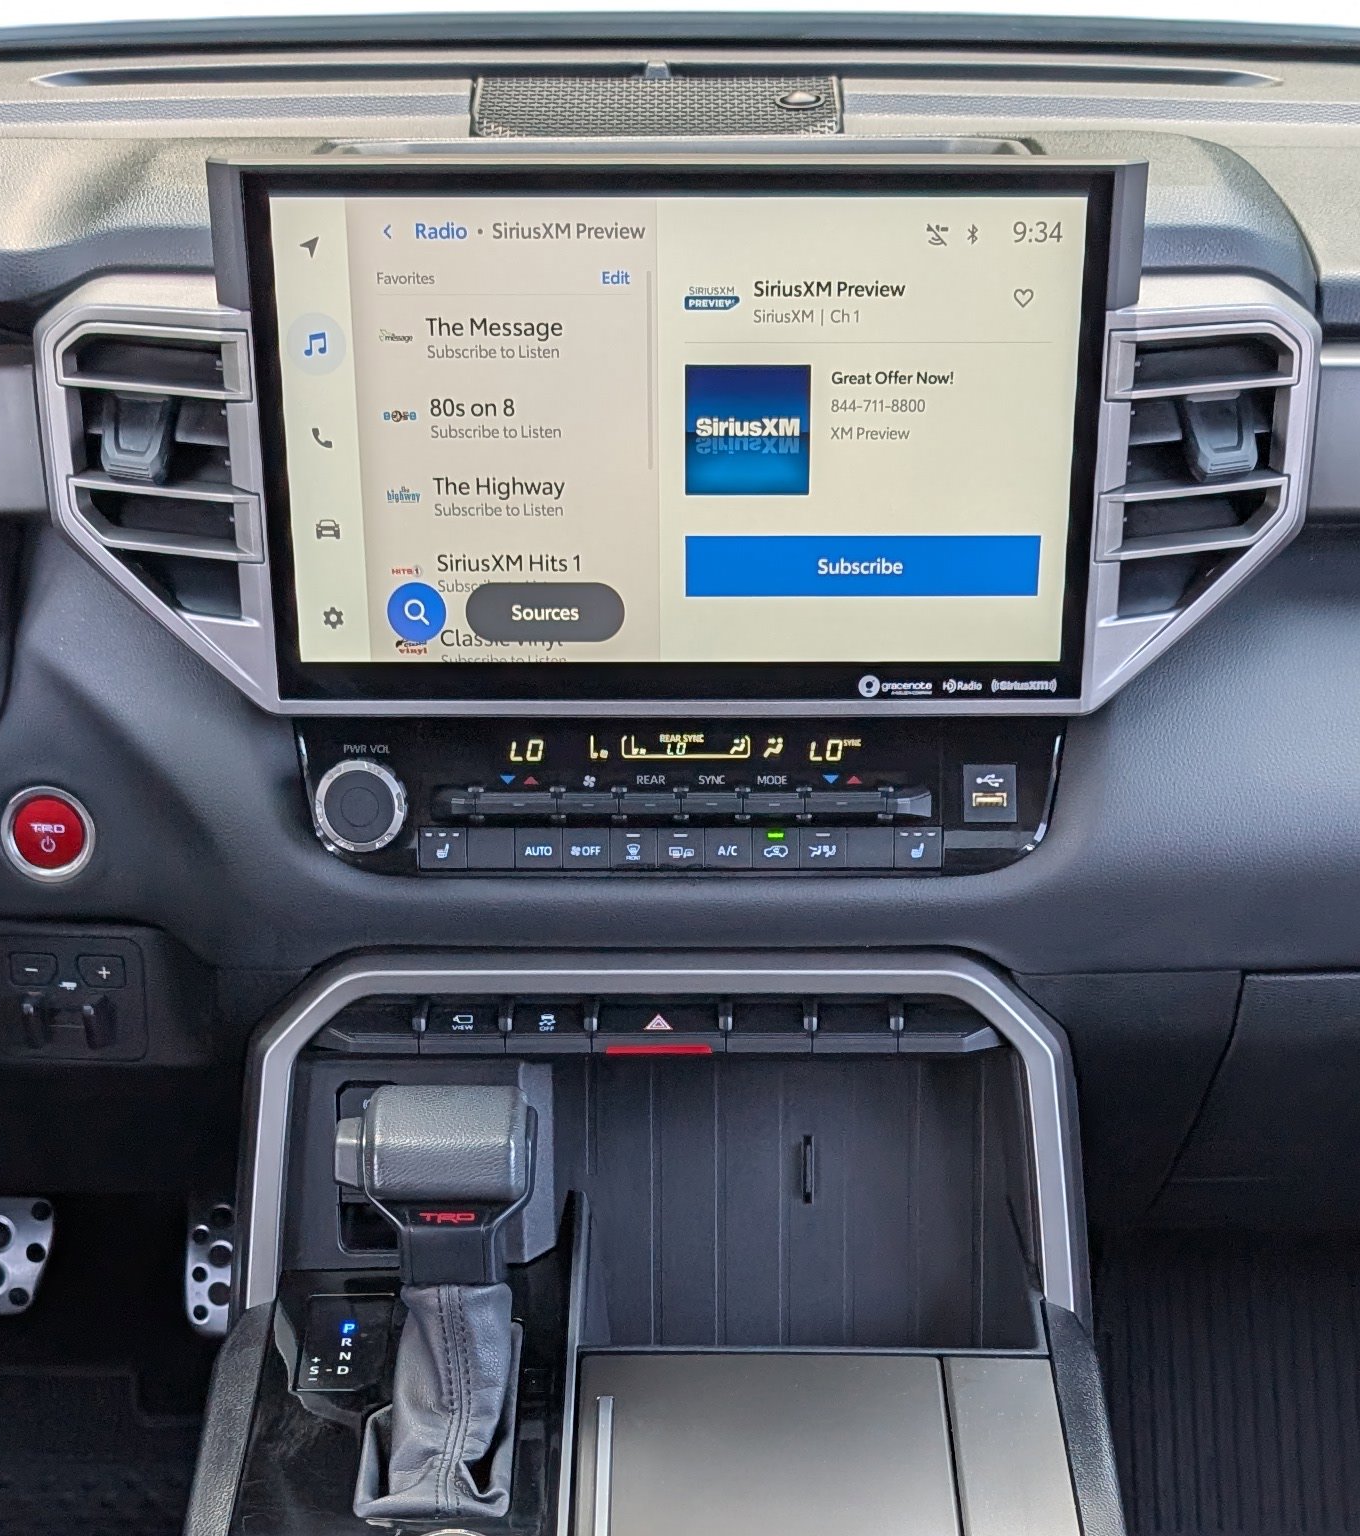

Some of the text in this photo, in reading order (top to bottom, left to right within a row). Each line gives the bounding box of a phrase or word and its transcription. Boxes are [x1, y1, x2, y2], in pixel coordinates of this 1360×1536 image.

[415, 222, 646, 240] Radio SiriusXM Preview
[1013, 222, 1062, 244] 9:34
[376, 272, 435, 285] Favorites
[602, 270, 631, 285] Edit
[754, 281, 905, 299] SiriusXM Preview
[753, 310, 814, 324] SiriusXM
[831, 310, 850, 324] Ch
[854, 310, 860, 324] 1
[426, 317, 564, 342] The Message
[427, 345, 560, 359] Subscribe to Listen
[831, 371, 954, 385] Great Offer Now!
[430, 399, 466, 417] 80s
[471, 403, 497, 417] on
[503, 399, 515, 417] 8
[830, 399, 926, 413] 844-711-8800
[430, 425, 562, 439] Subscribe to Listen
[695, 416, 801, 438] SiriusXM
[830, 427, 910, 442] XM Preview
[433, 477, 565, 501] The Highway
[434, 503, 564, 517] Subscribe to Listen
[437, 554, 581, 572] SiriusXM Hits 1
[817, 558, 904, 575] Subscribe
[511, 605, 580, 621] Sources
[881, 680, 933, 690] gracenote
[957, 681, 982, 690] Radio
[660, 734, 704, 743] REAR SYNC
[343, 744, 391, 753] PWR VOL
[636, 775, 666, 784] REAR
[698, 775, 726, 785] SYNC
[757, 775, 788, 784] MODE
[30, 823, 65, 834] TRD
[525, 846, 553, 856] AUTO
[582, 846, 601, 856] OFF
[717, 845, 738, 856] A/C
[419, 1211, 476, 1224] TRD
[342, 1323, 355, 1334] P
[340, 1337, 352, 1347] R
[339, 1351, 352, 1361] N
[309, 1365, 350, 1375] S D
